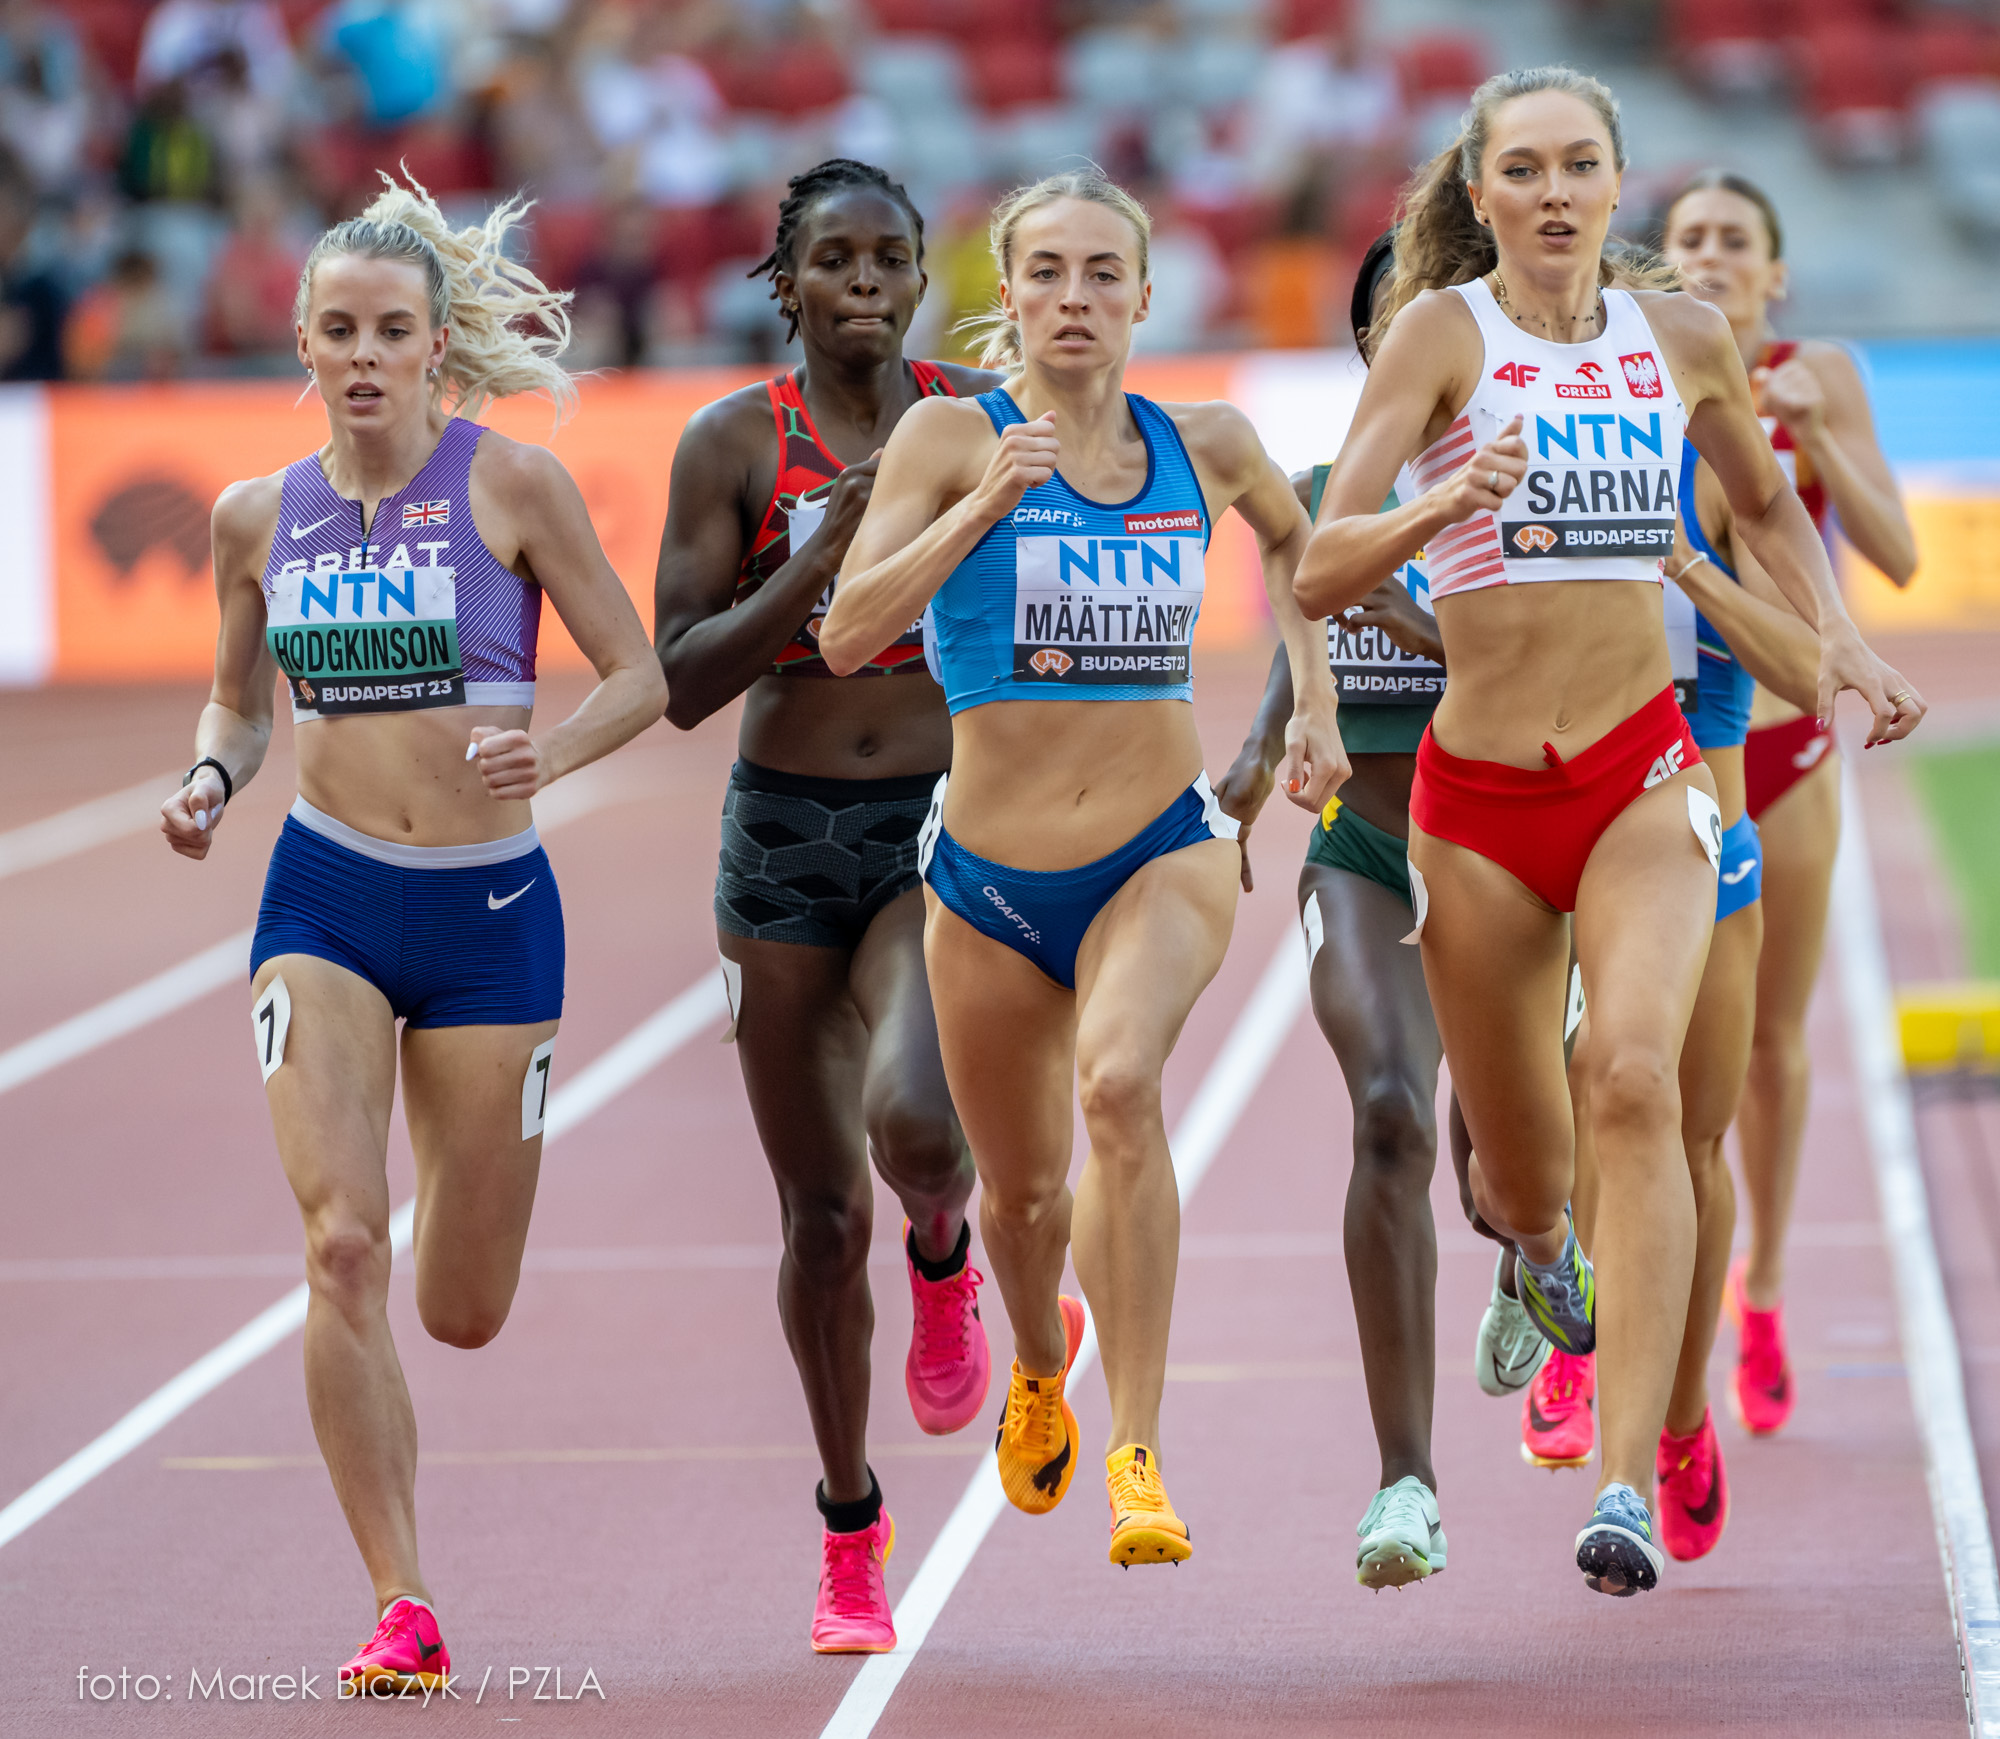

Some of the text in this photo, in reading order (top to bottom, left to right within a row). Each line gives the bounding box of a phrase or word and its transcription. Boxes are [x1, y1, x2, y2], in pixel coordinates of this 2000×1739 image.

[1493, 361, 1541, 388] 4F
[1558, 386, 1608, 398] ORLEN
[1536, 412, 1663, 461] NTN
[1527, 469, 1675, 515] SARNA
[1013, 508, 1071, 524] CRAFT
[1128, 514, 1199, 531] motonet
[1565, 529, 1669, 546] BUDAPEST
[1059, 538, 1181, 587] NTN
[300, 570, 416, 620] NTN
[1025, 595, 1193, 642] MÄÄTTÄNEN
[274, 625, 450, 673] HODGKINSON
[322, 679, 452, 702] BUDAPEST 23
[1343, 675, 1447, 692] BUDAPEST
[1643, 738, 1684, 789] 4F
[982, 885, 1032, 932] CRAFT
[259, 998, 274, 1067] 7
[536, 1053, 551, 1121] 7
